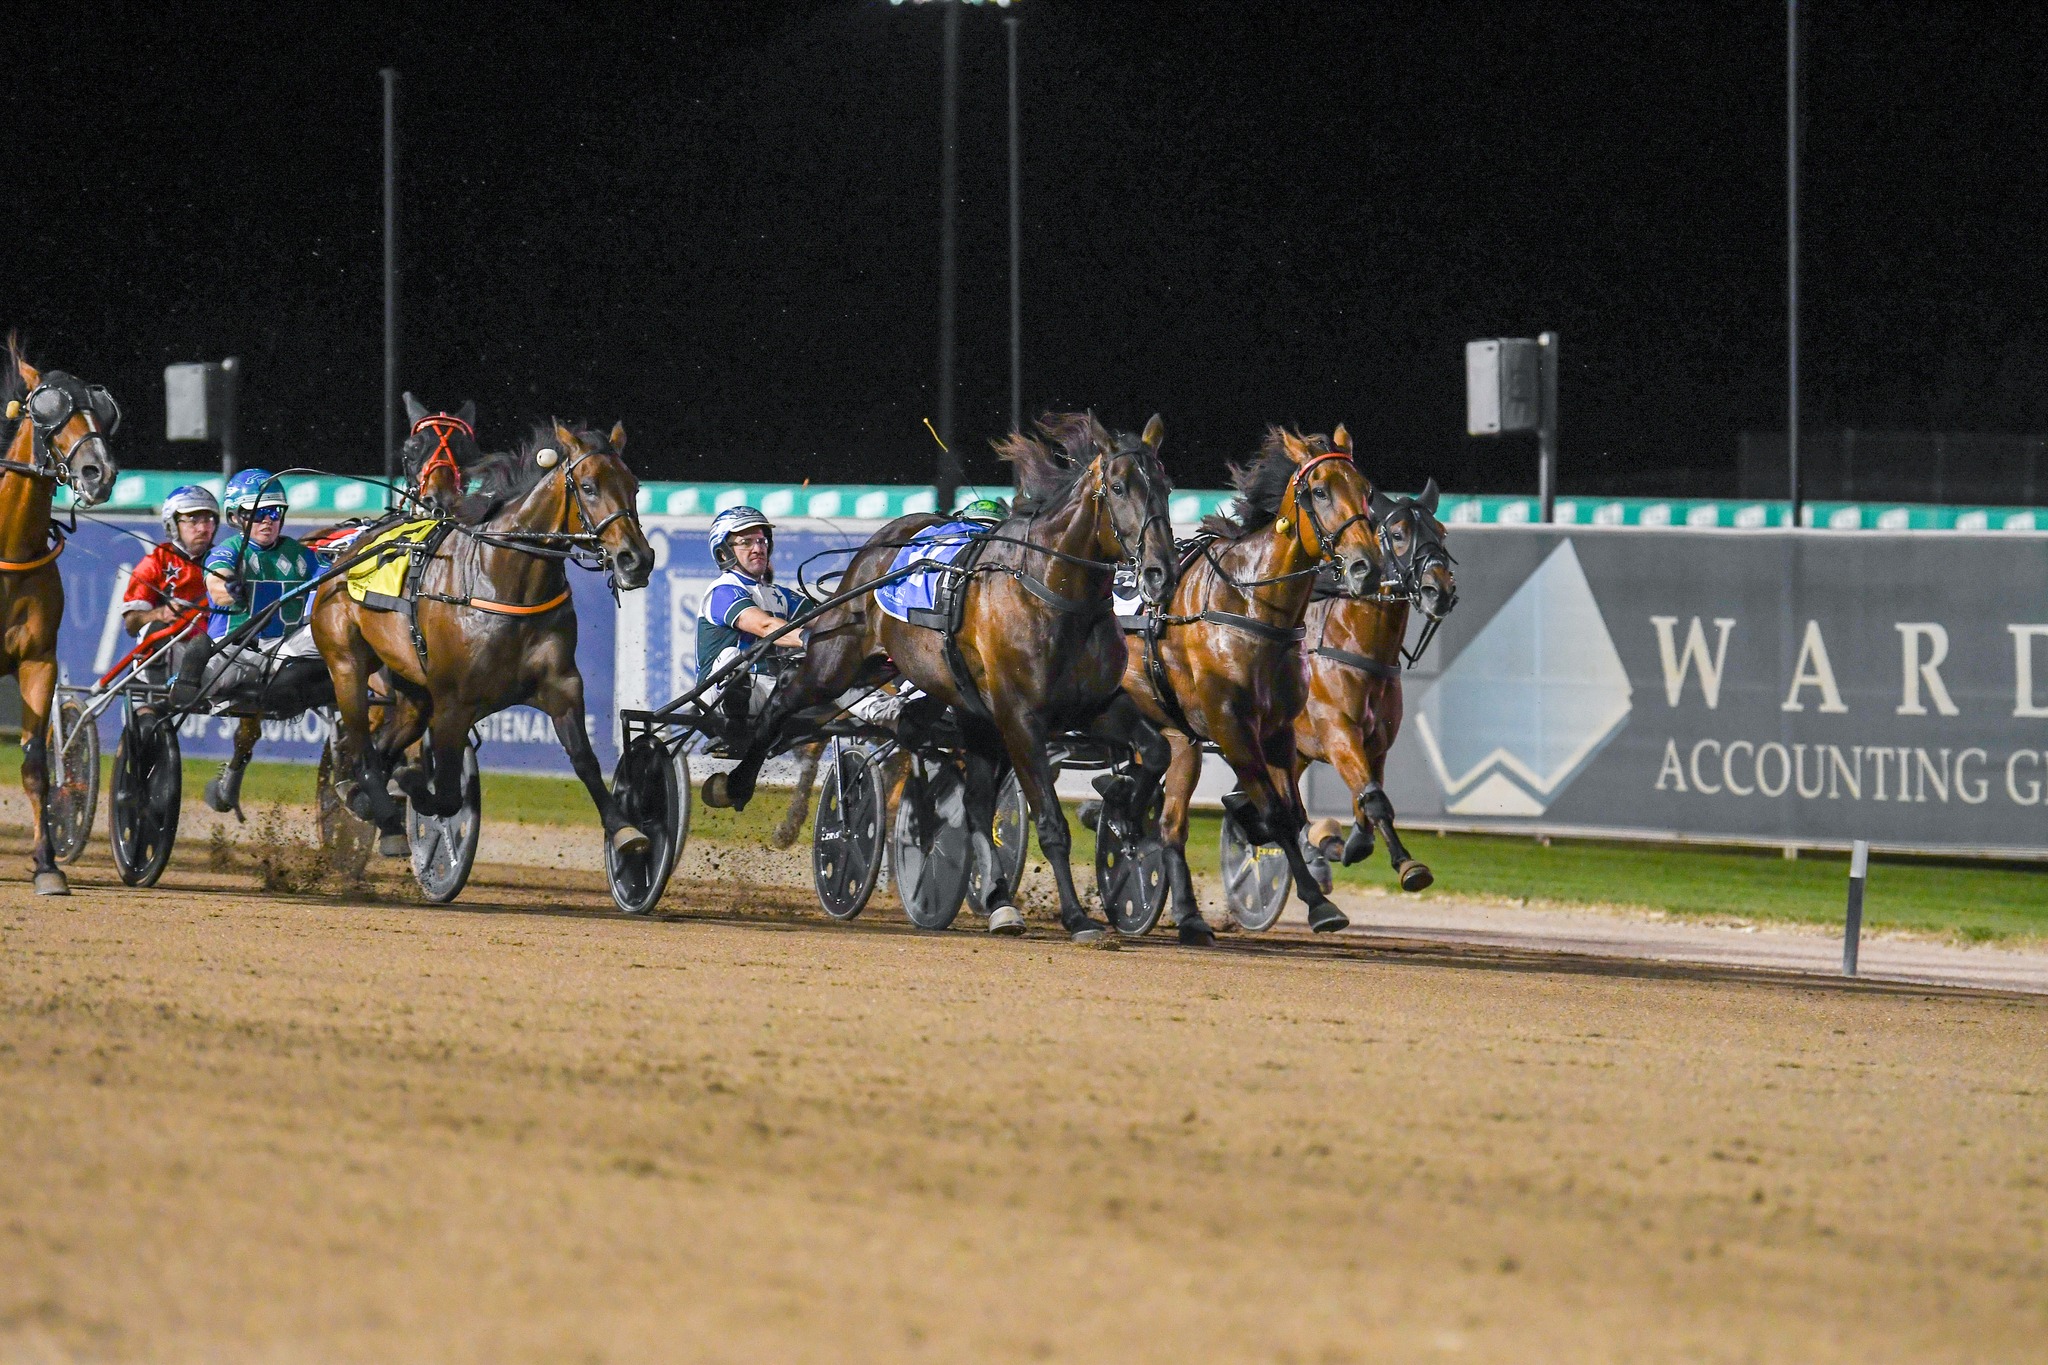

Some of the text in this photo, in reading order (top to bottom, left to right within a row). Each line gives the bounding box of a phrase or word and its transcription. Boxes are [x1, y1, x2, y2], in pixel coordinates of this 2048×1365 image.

[1649, 615, 2048, 718] WARD
[1655, 736, 2048, 806] ACCOUNTING G
